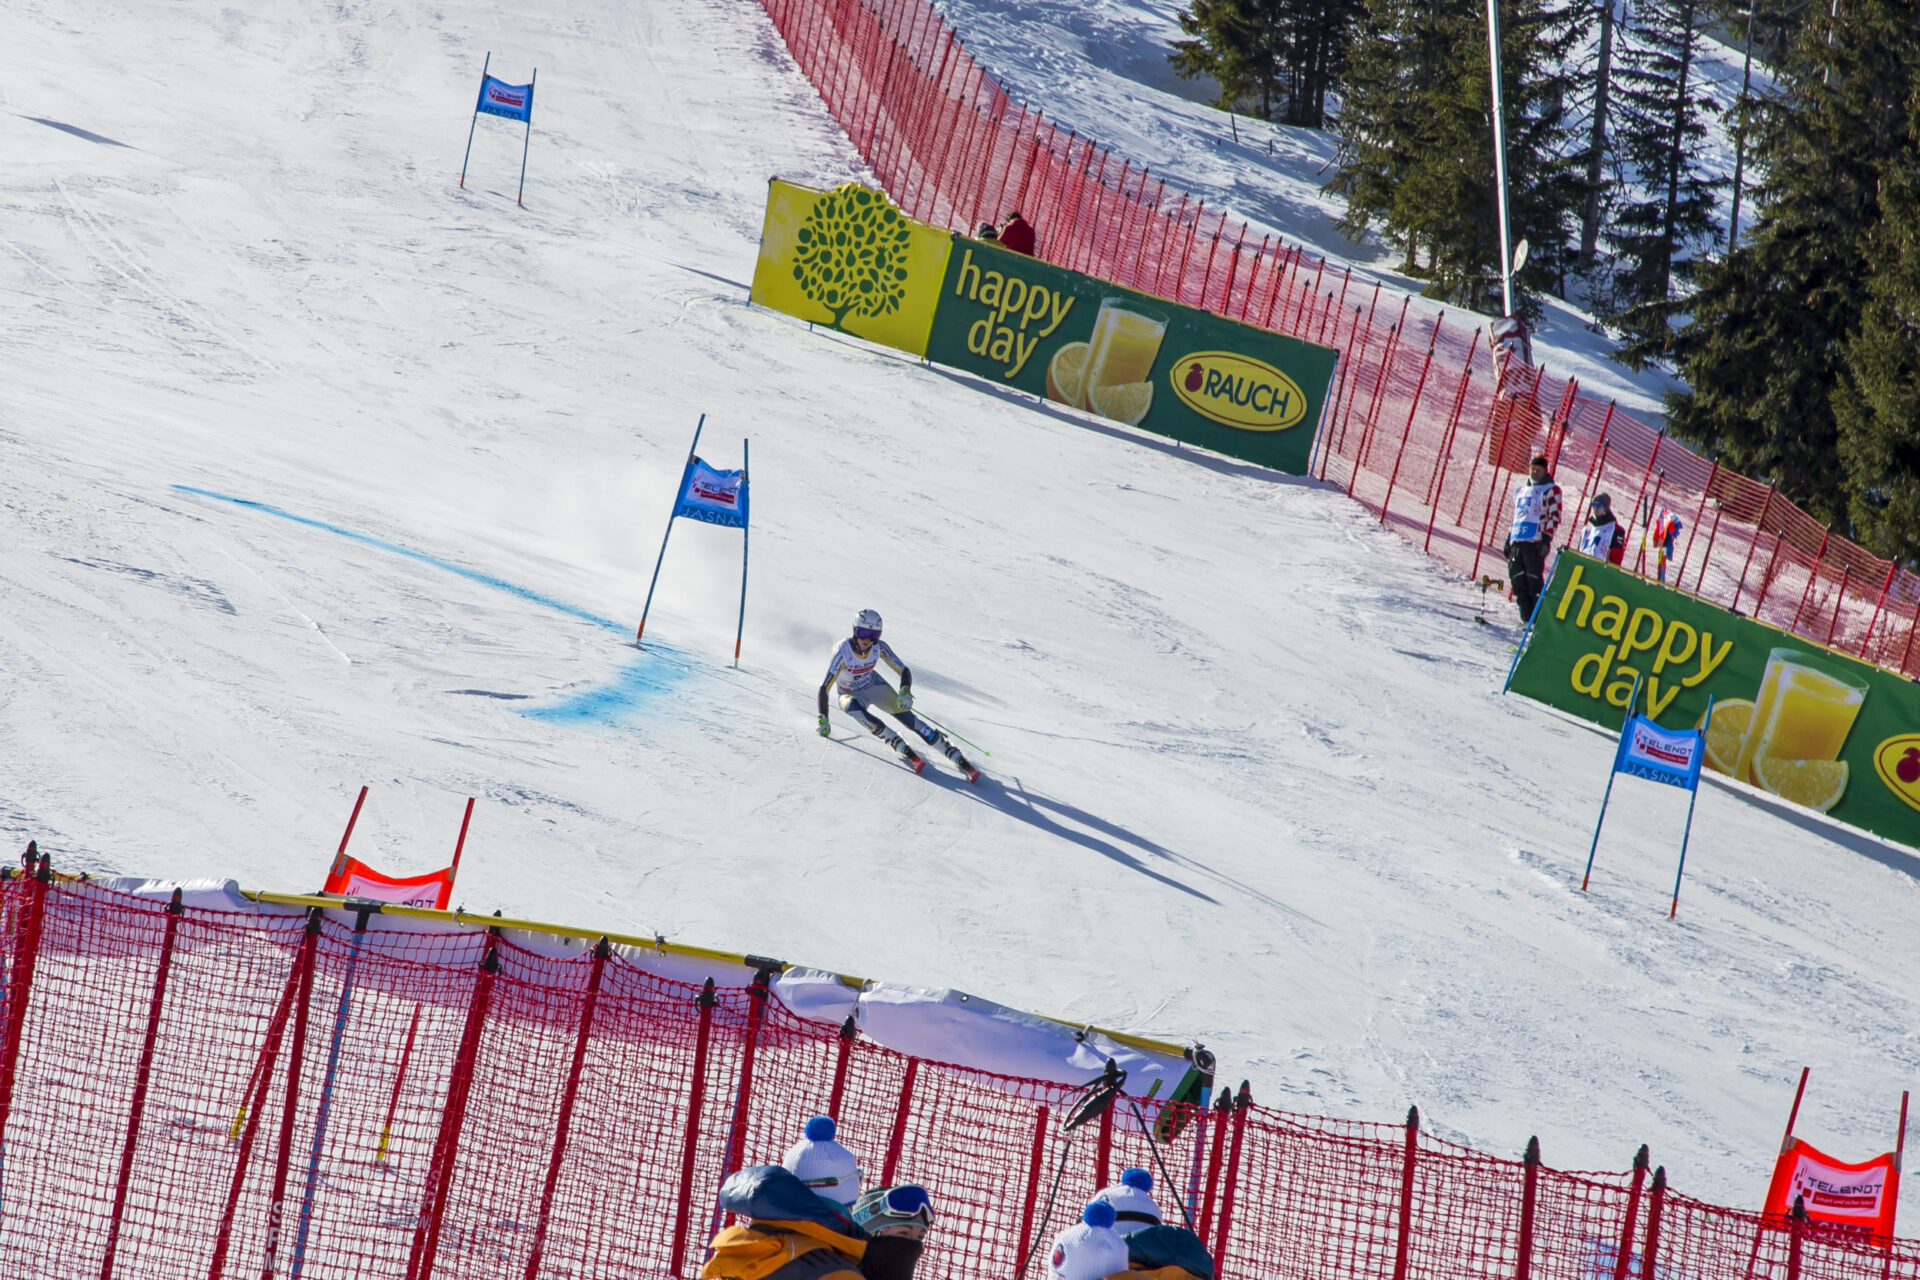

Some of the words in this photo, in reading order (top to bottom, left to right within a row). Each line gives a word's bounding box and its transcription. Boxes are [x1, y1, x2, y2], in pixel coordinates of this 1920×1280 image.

[956, 249, 1076, 337] happy
[967, 311, 1040, 379] day
[1203, 368, 1291, 418] RAUCH
[1555, 565, 1734, 687] happy
[1571, 644, 1681, 721] day
[1627, 764, 1681, 786] JASNA
[1808, 1176, 1883, 1194] TELENOT
